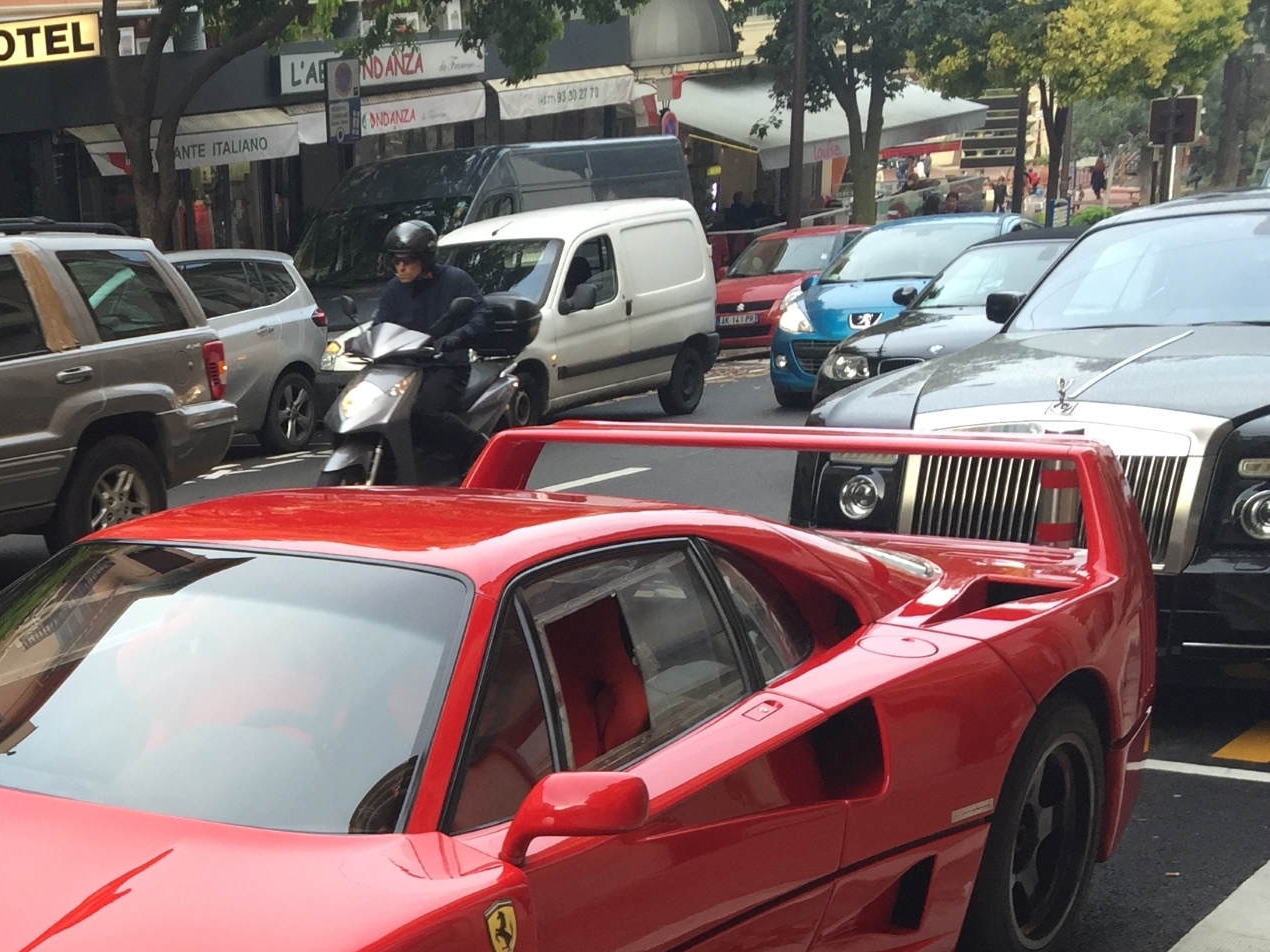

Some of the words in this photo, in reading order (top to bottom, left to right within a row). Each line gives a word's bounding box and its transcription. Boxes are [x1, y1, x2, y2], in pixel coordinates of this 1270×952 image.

[557, 91, 566, 103] 93
[569, 90, 577, 101] 30
[579, 88, 588, 100] 27
[590, 86, 599, 98] 70
[212, 136, 268, 156] ITALIANO
